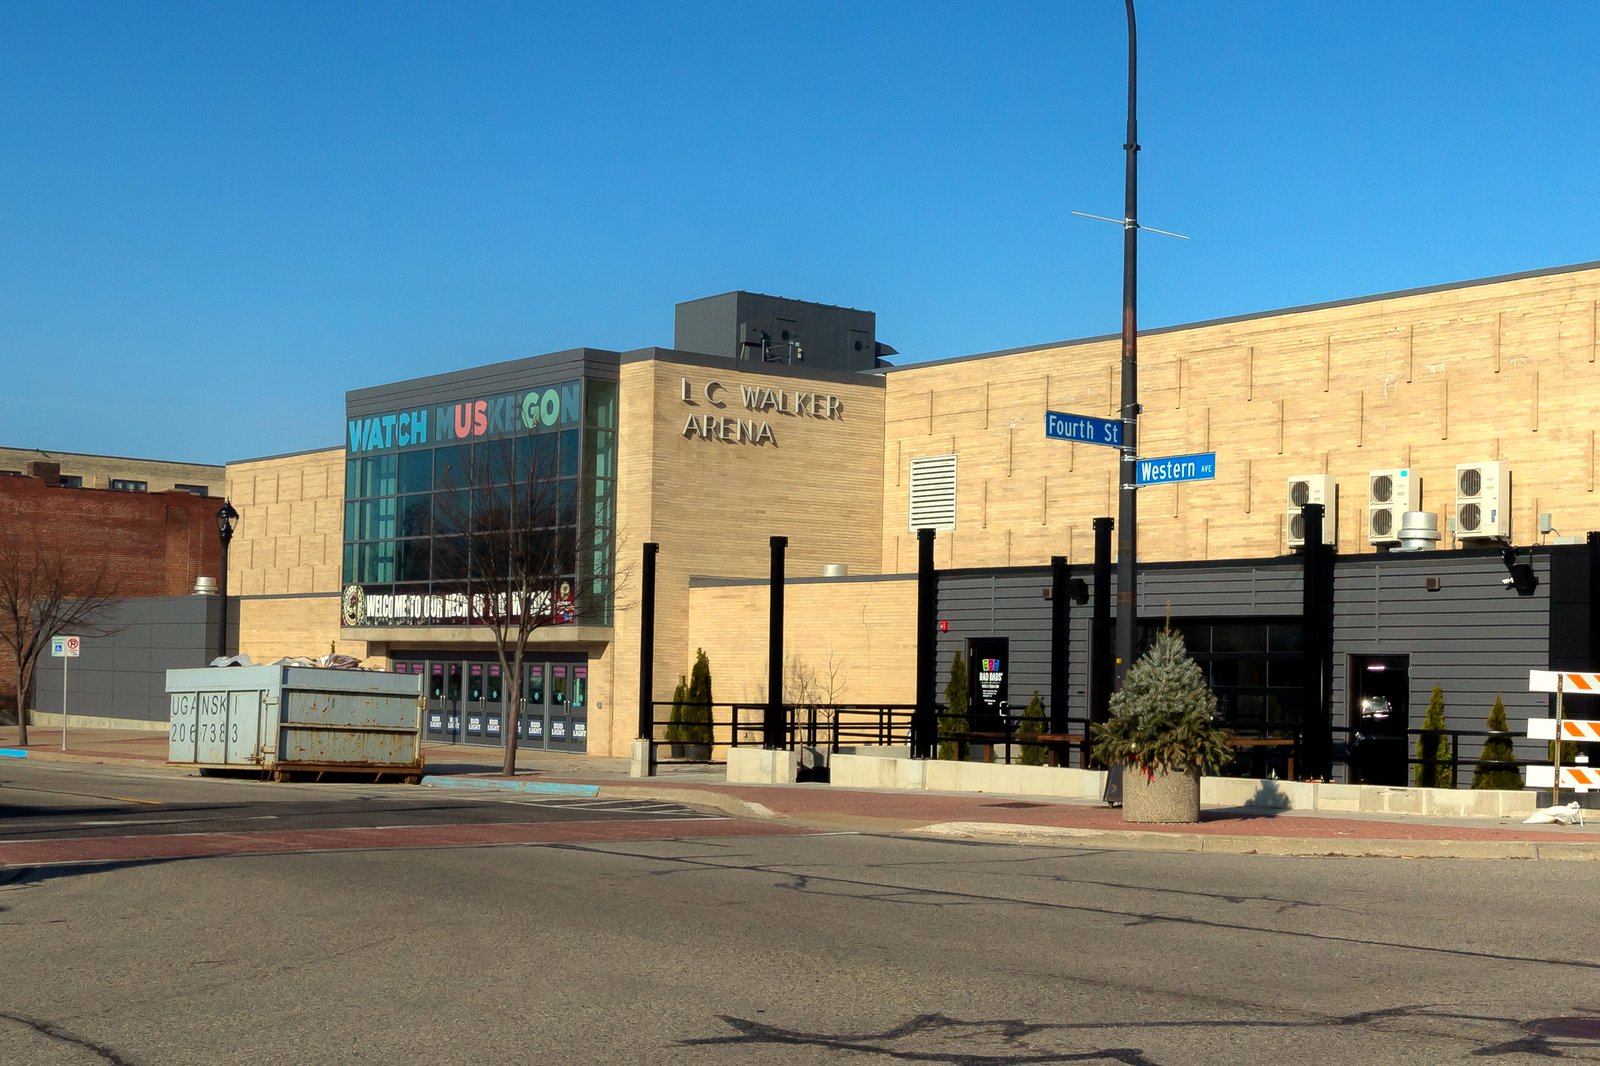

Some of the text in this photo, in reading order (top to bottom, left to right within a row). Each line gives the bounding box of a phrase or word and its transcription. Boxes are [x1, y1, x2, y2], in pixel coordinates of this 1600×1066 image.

[681, 377, 844, 421] L C WALKER
[348, 409, 428, 452] WATCH
[681, 413, 775, 444] ARENA
[1049, 415, 1118, 443] Fourth St
[1141, 461, 1212, 481] Western AVE
[366, 594, 408, 618] WELCOME
[410, 595, 421, 618] TO
[424, 594, 443, 618] OUR
